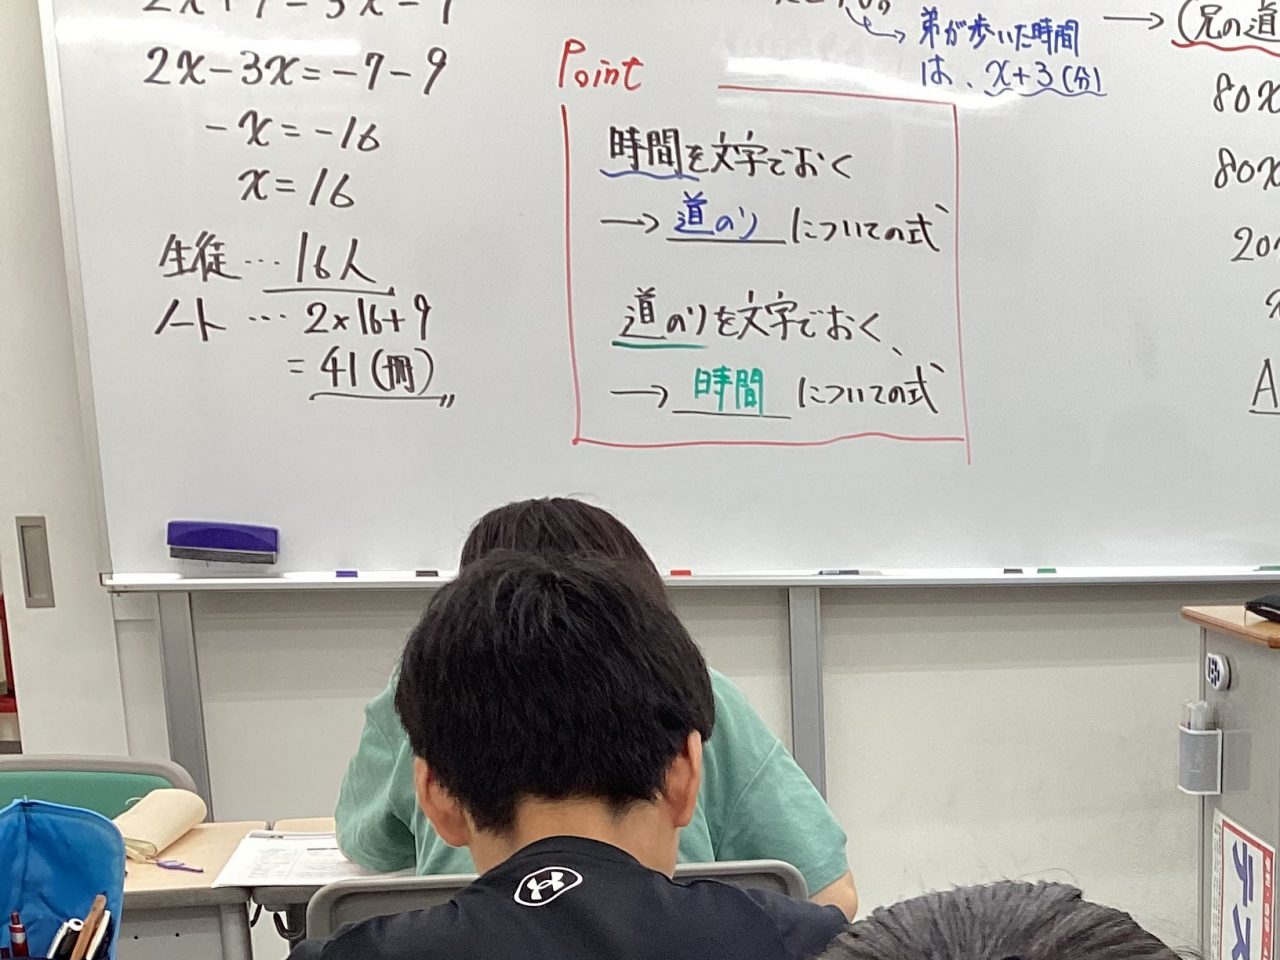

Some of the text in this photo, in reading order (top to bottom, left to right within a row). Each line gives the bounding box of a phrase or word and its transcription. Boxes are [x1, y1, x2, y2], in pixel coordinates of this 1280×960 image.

[919, 6, 1080, 57] 弟が歩いた時間
[559, 39, 644, 90] Point
[608, 126, 854, 180] 時間を文字でおく
